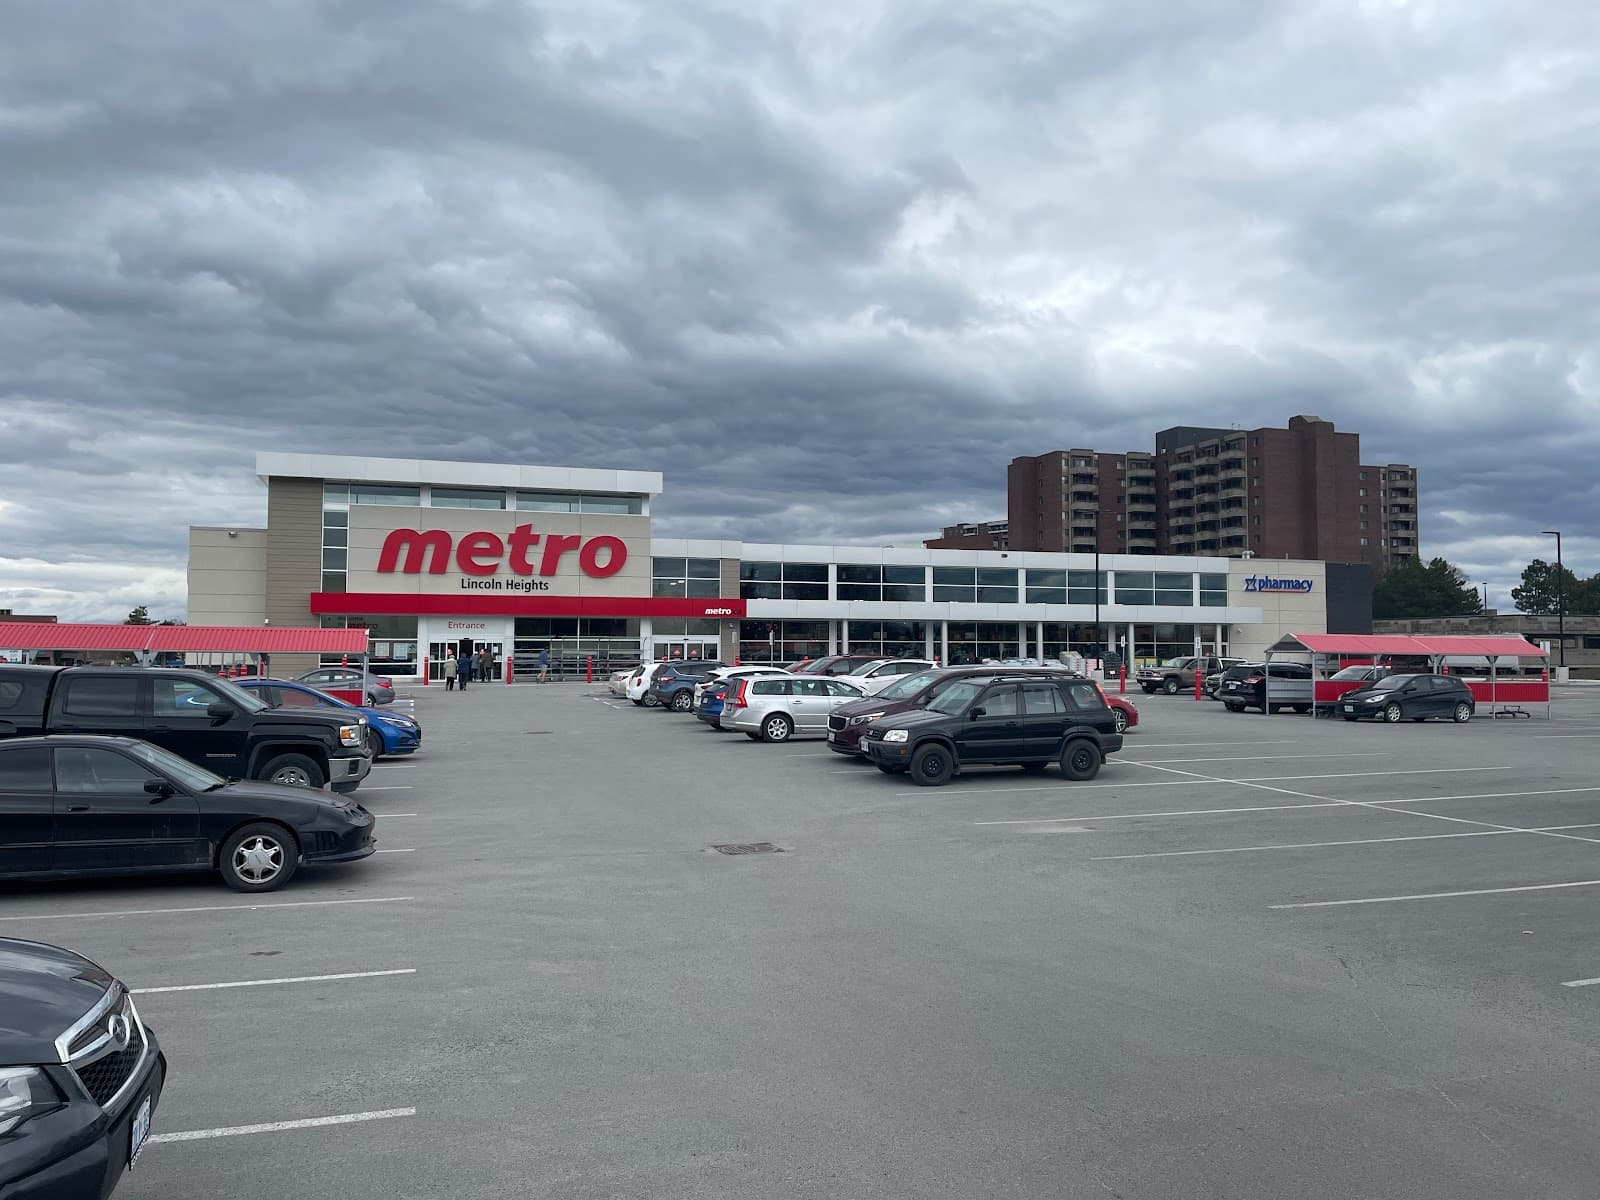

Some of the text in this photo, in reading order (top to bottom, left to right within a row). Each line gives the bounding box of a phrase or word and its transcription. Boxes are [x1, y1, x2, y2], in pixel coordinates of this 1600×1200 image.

[378, 524, 627, 578] metro
[461, 578, 550, 593] Lincoln Heights
[1258, 575, 1313, 593] pharmacy
[447, 621, 486, 630] Entrance
